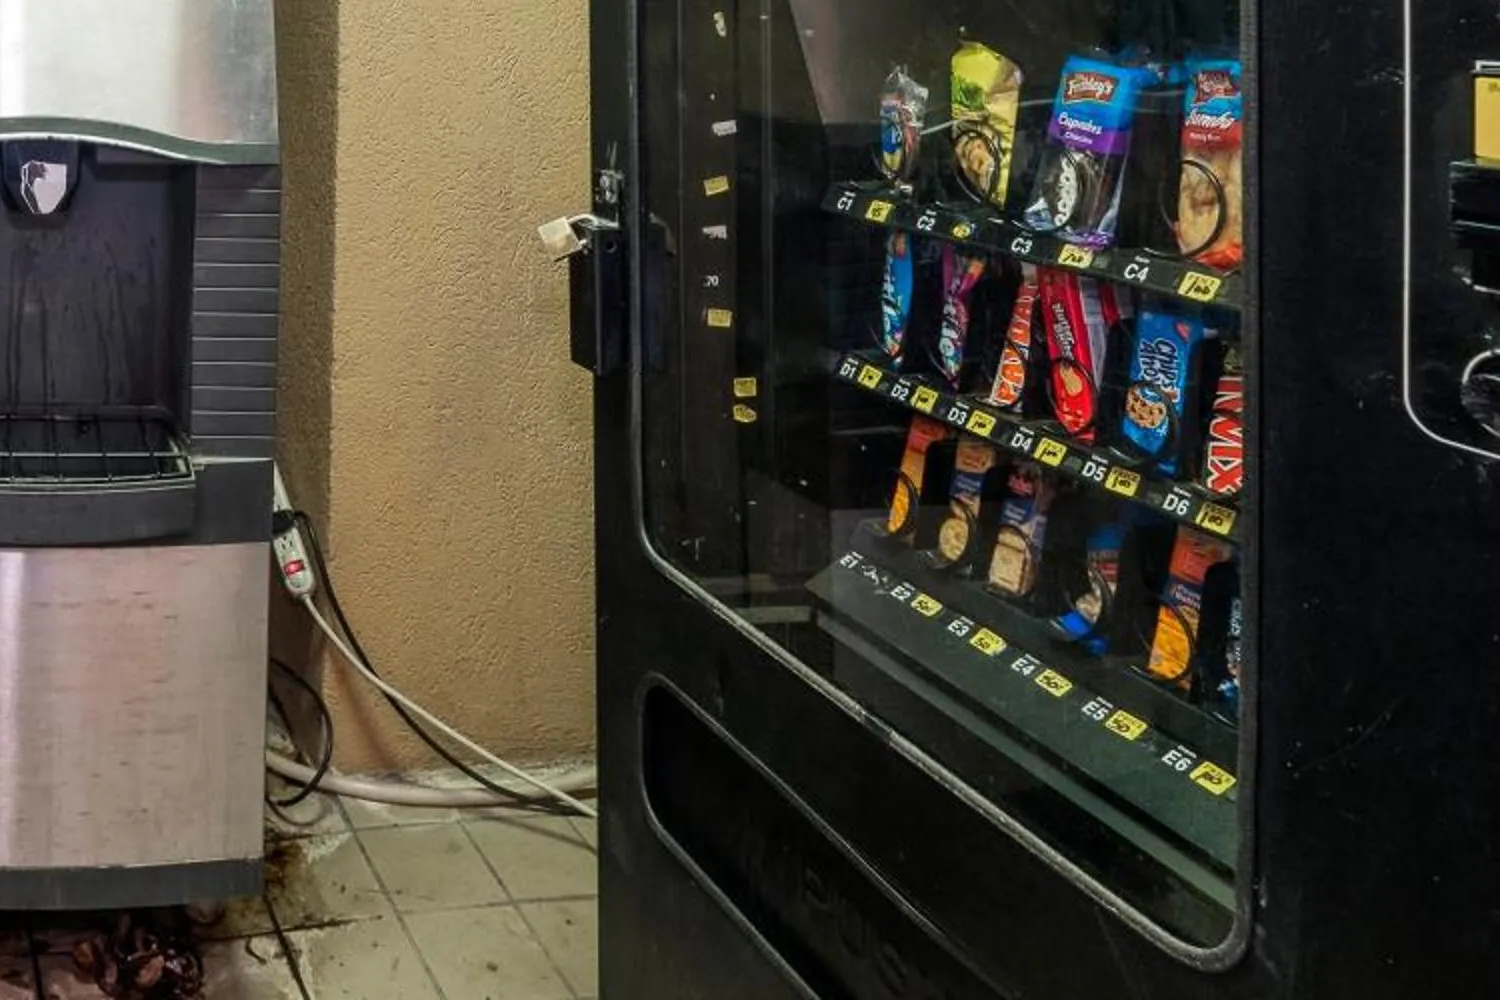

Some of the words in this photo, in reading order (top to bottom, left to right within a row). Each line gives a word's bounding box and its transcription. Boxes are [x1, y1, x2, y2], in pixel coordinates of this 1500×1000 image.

[837, 197, 853, 211] C1
[917, 215, 936, 232] C2
[1011, 237, 1033, 255] C3
[1124, 263, 1150, 282] C4
[839, 362, 856, 379] D1
[891, 383, 909, 401] D2
[948, 407, 967, 425] D3
[1011, 432, 1034, 451] D4
[1082, 461, 1107, 482] D5
[1162, 493, 1190, 516] D6
[890, 585, 912, 601] E2
[948, 619, 970, 637] E3
[1011, 657, 1036, 676] E4
[1081, 700, 1110, 721] E5
[1161, 749, 1192, 772] E6
